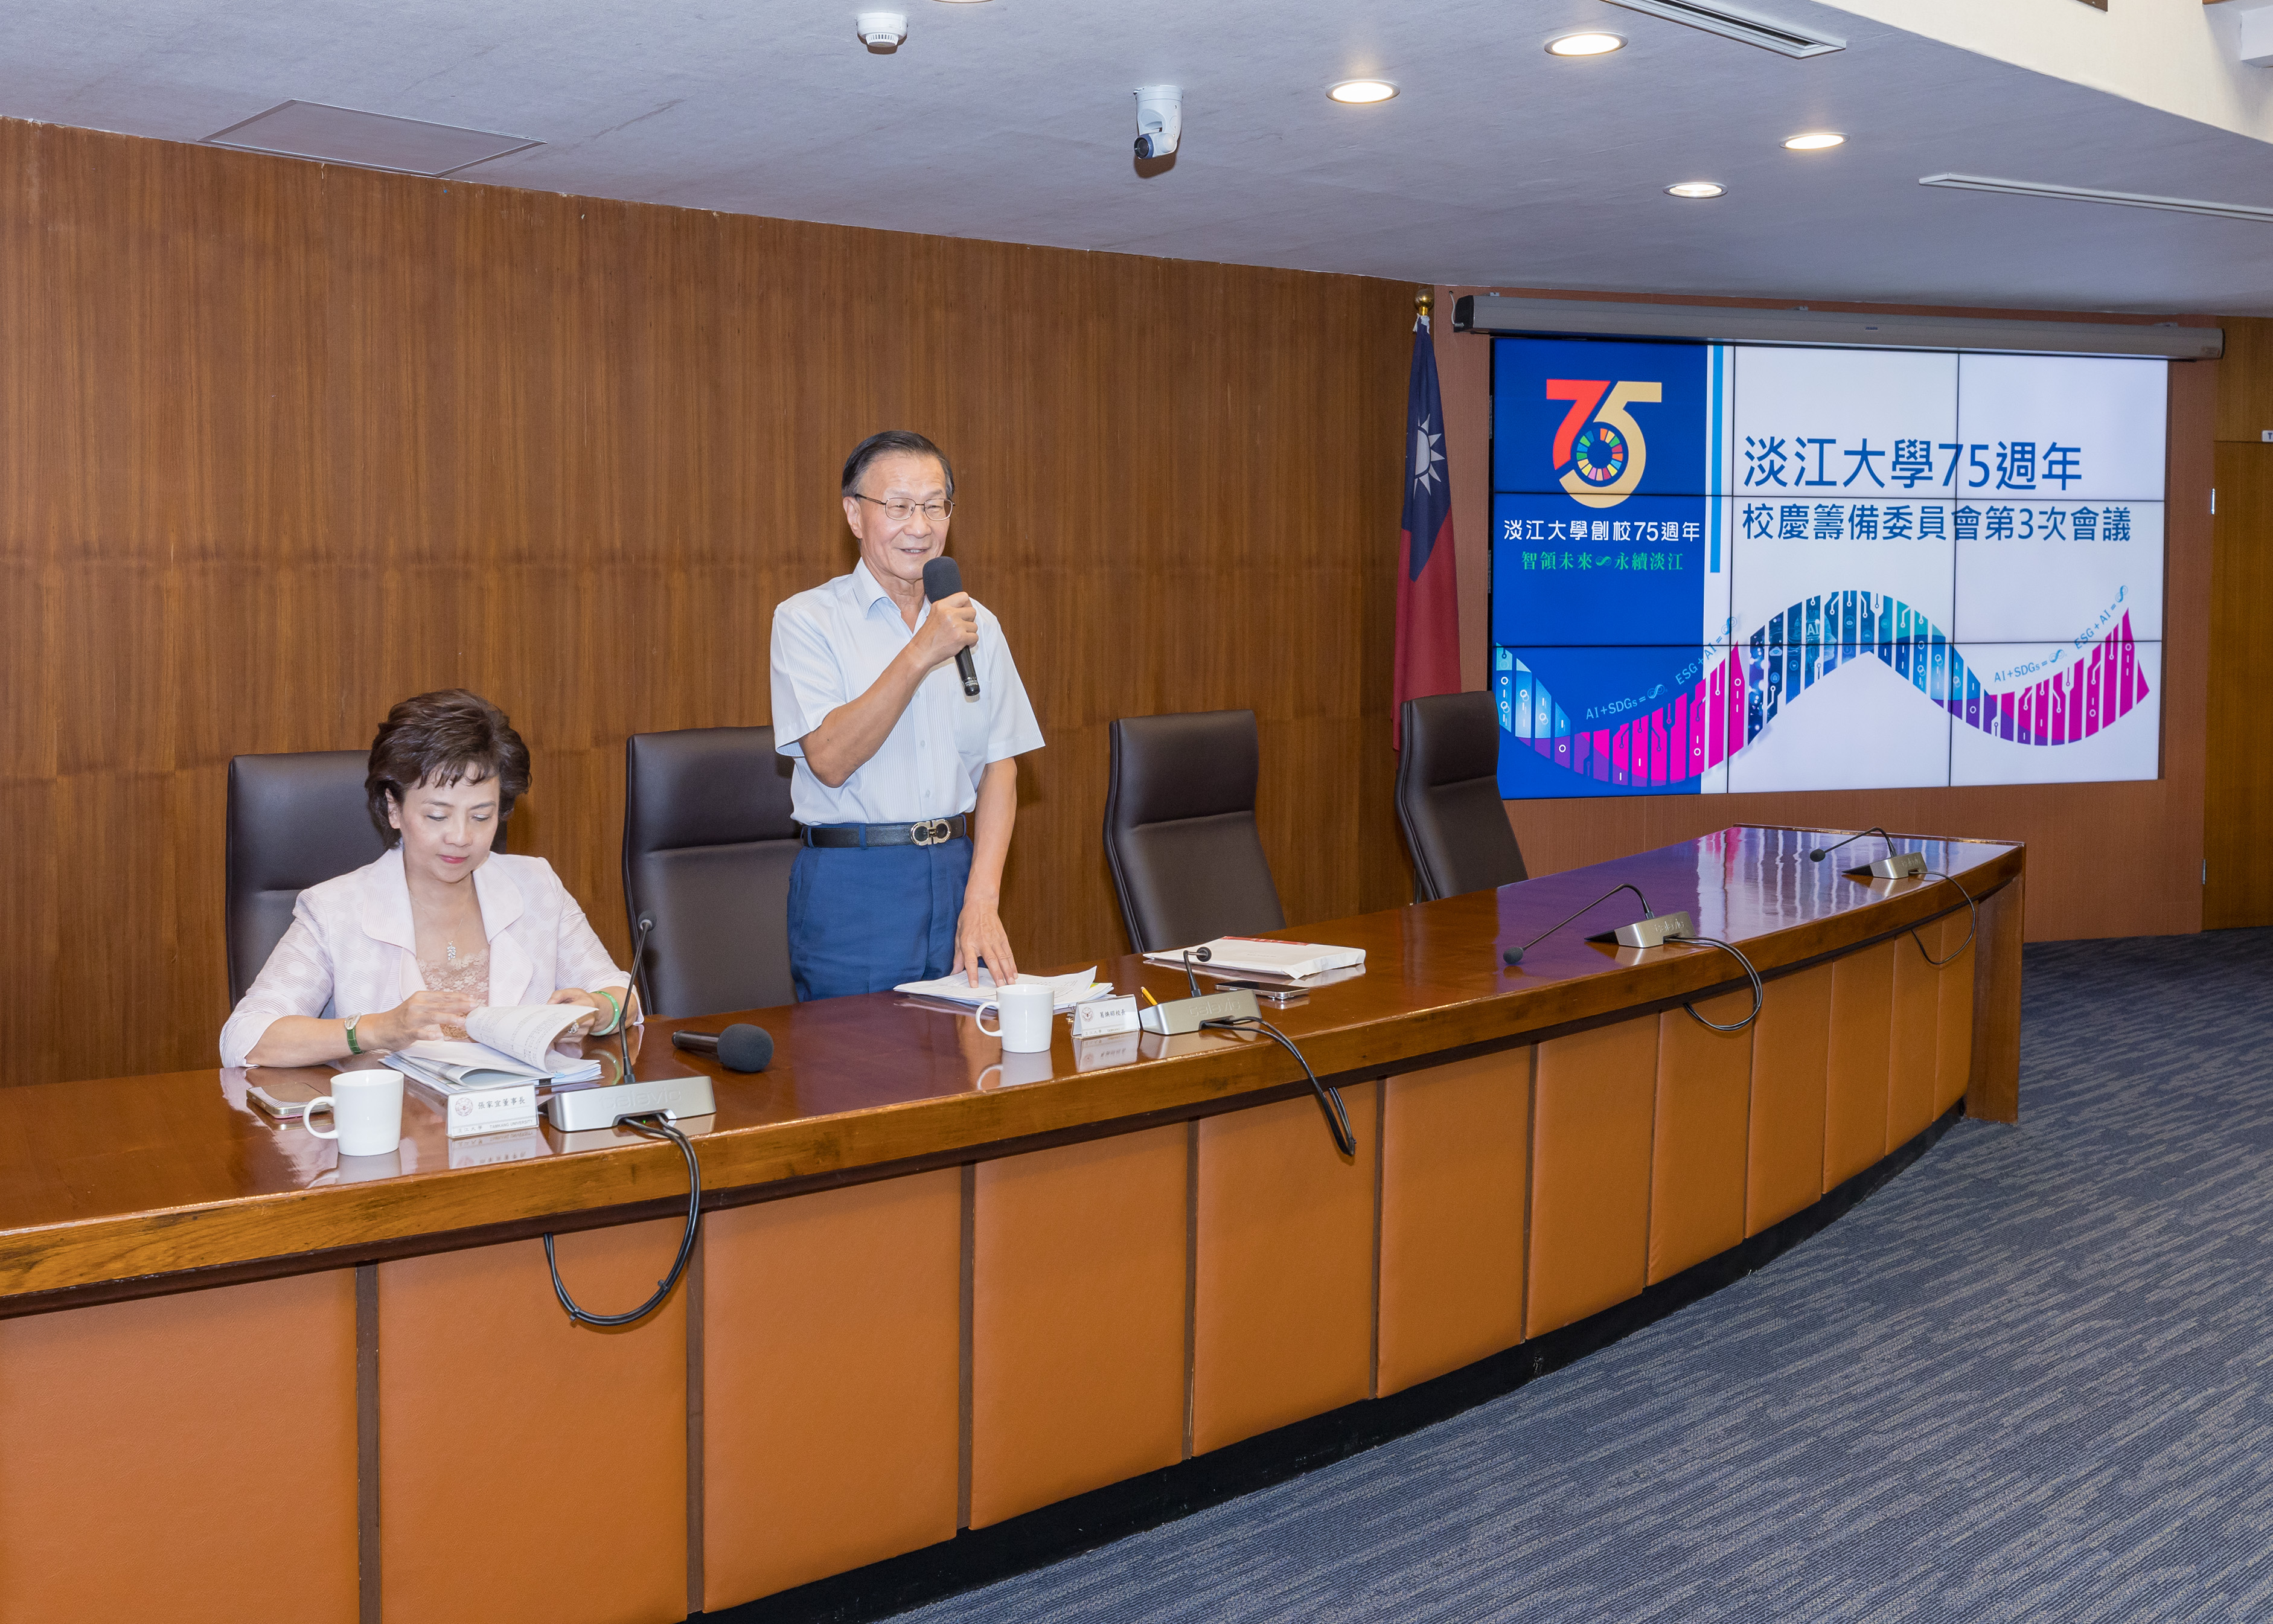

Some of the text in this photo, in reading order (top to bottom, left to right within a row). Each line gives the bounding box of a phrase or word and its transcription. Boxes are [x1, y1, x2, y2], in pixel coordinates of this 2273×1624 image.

[1546, 379, 1662, 509] 75
[1744, 435, 2082, 490] 淡江大學75週年
[1504, 520, 1700, 542] 淡江大學創校75週年
[1742, 503, 2131, 542] 校慶籌備委員會第3次會議
[478, 1096, 526, 1110] 張家宜董事長
